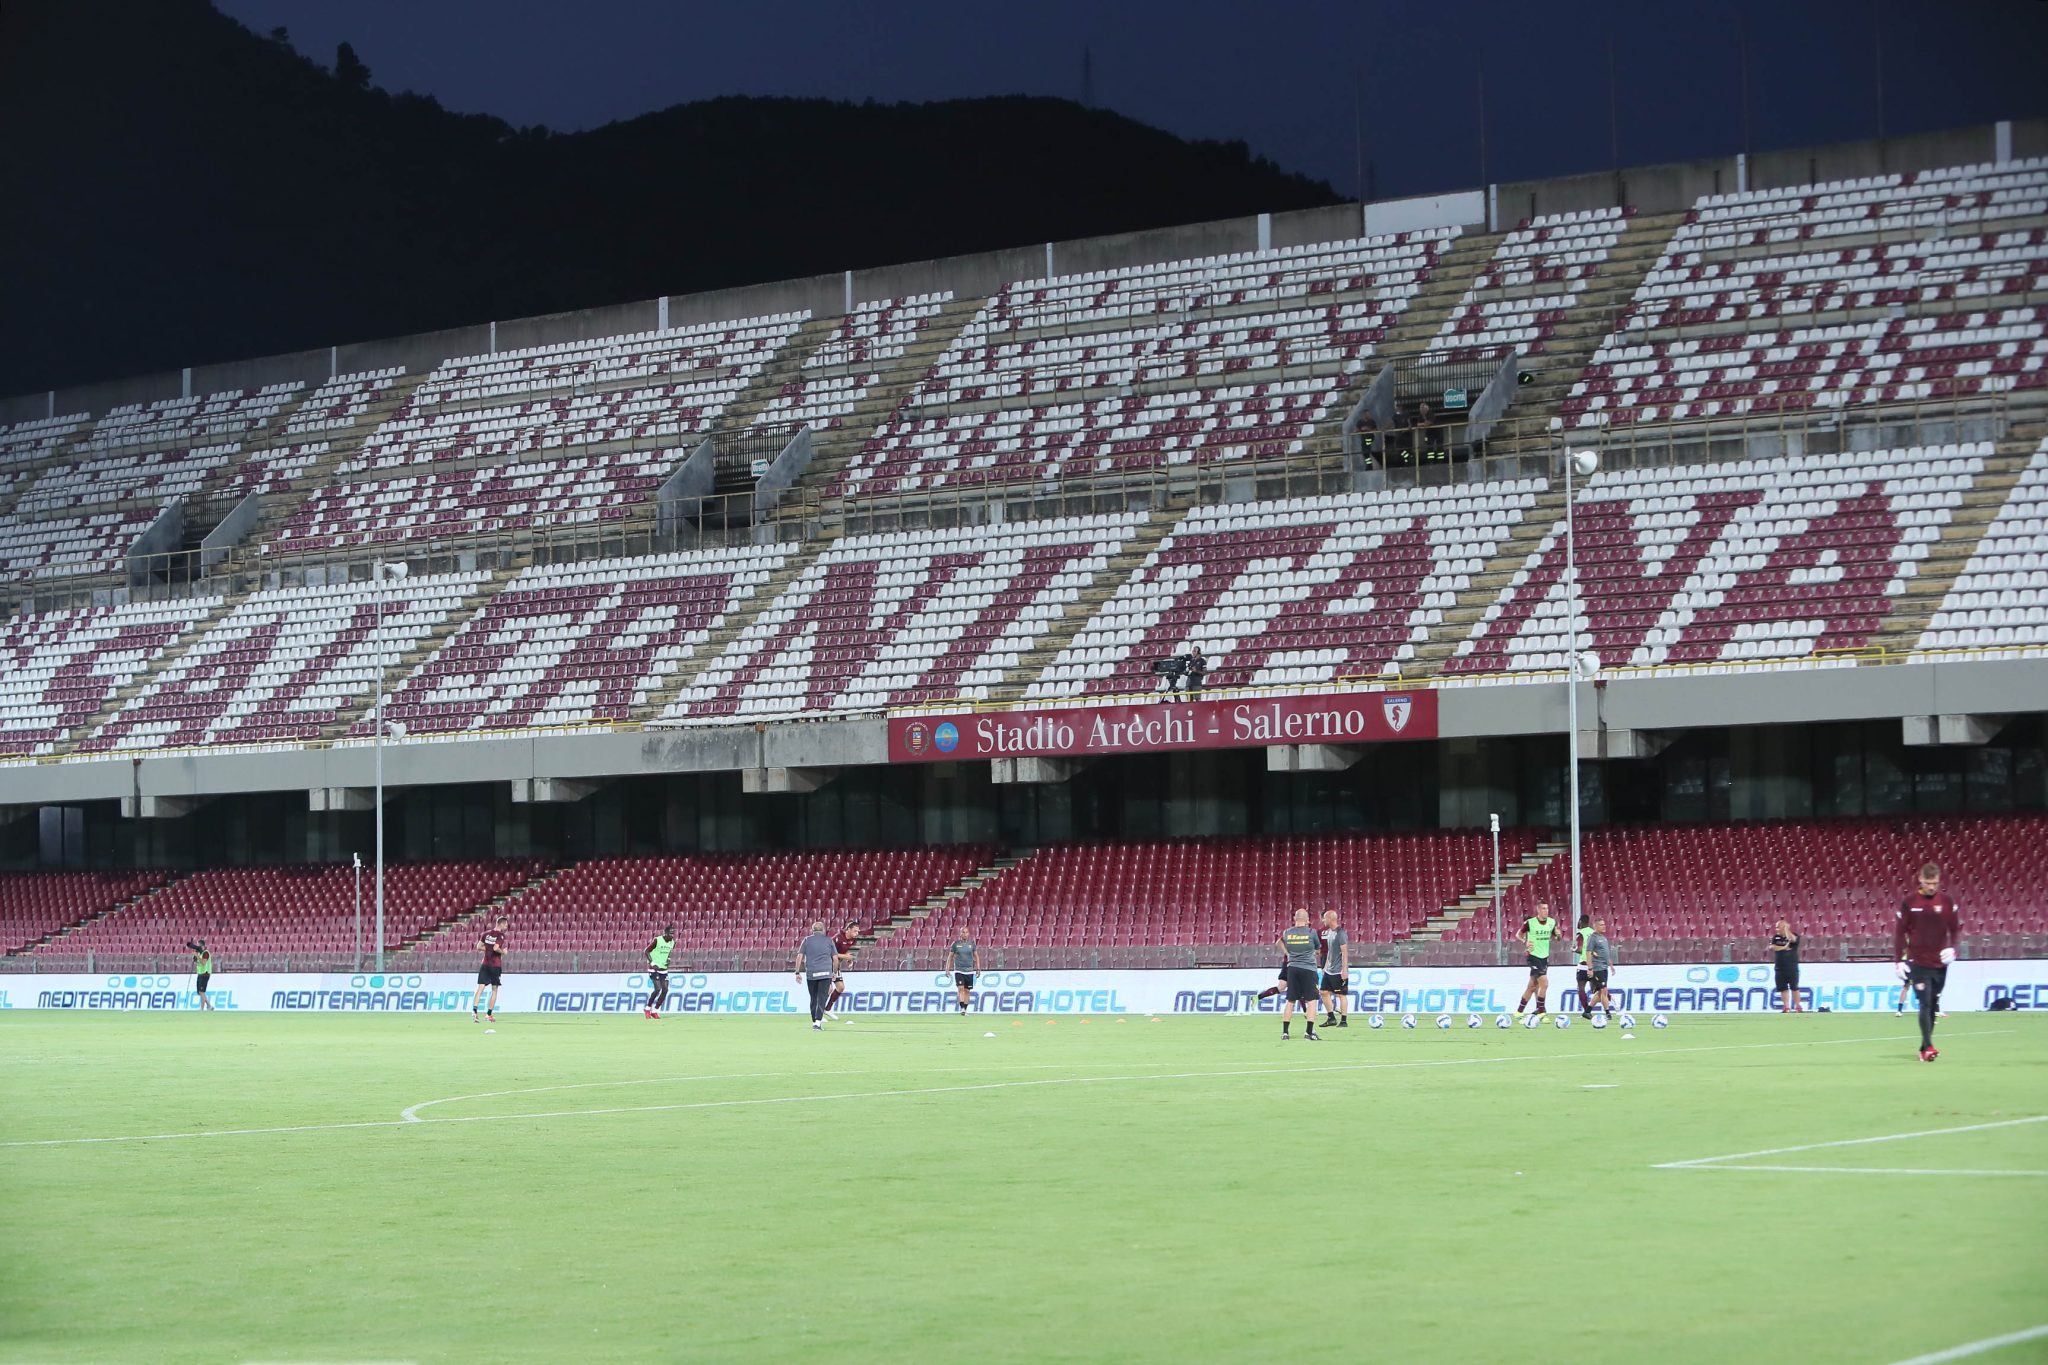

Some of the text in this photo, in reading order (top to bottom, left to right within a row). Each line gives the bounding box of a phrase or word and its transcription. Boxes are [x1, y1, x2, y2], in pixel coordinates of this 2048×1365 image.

[977, 717, 1075, 753] Stadio
[1087, 710, 1196, 748] Arechi
[1233, 703, 1365, 740] Salerno
[537, 991, 797, 1012] MEDITERRNEAHOTEL
[1174, 988, 1506, 1013] MEDITERNEAHOTEL
